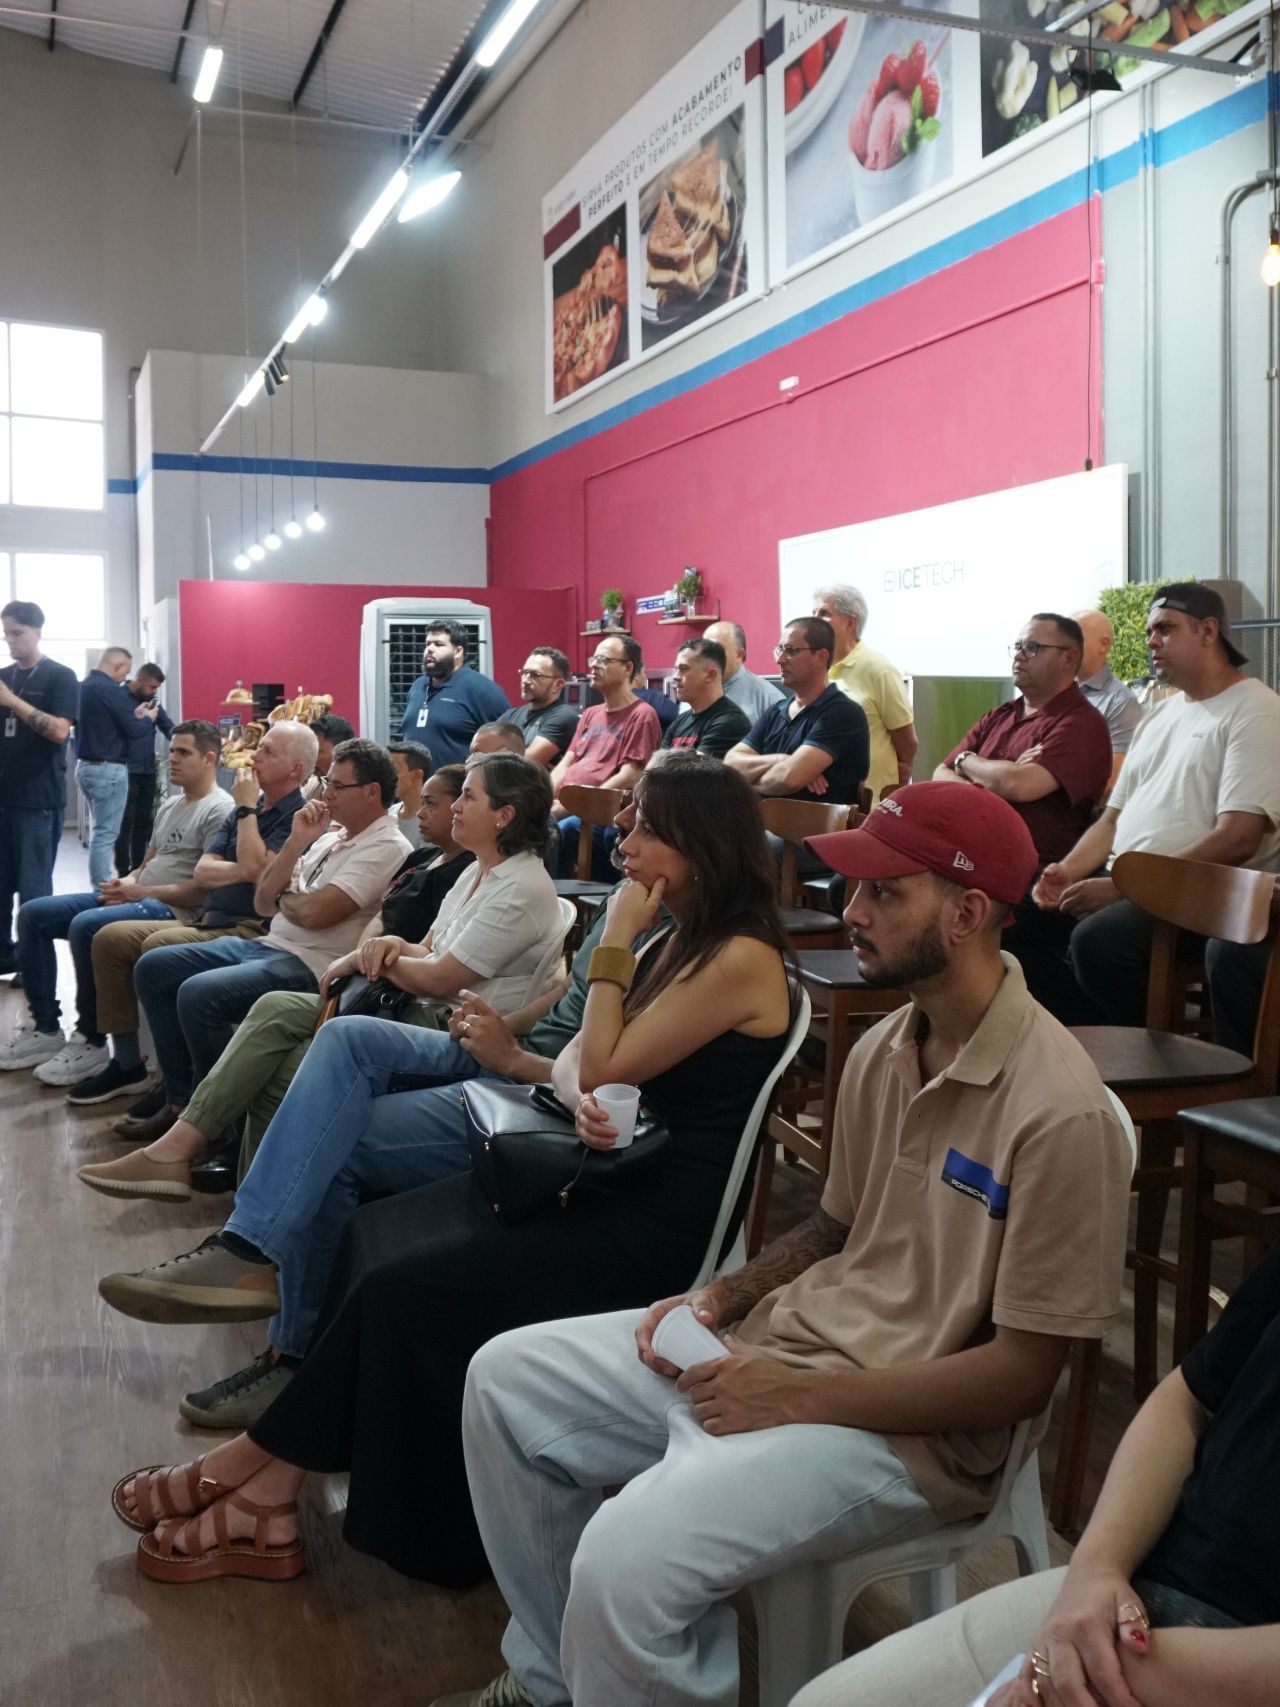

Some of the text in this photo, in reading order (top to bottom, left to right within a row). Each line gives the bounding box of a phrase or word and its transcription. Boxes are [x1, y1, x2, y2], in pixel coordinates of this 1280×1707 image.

[788, 7, 832, 47] ALIME
[605, 141, 646, 185] PRODUTOS
[650, 120, 668, 146] COM
[673, 56, 741, 126] ACABAMENTO
[589, 180, 623, 218] PERFEITO
[634, 161, 645, 179] EM
[648, 132, 678, 166] TEMPO
